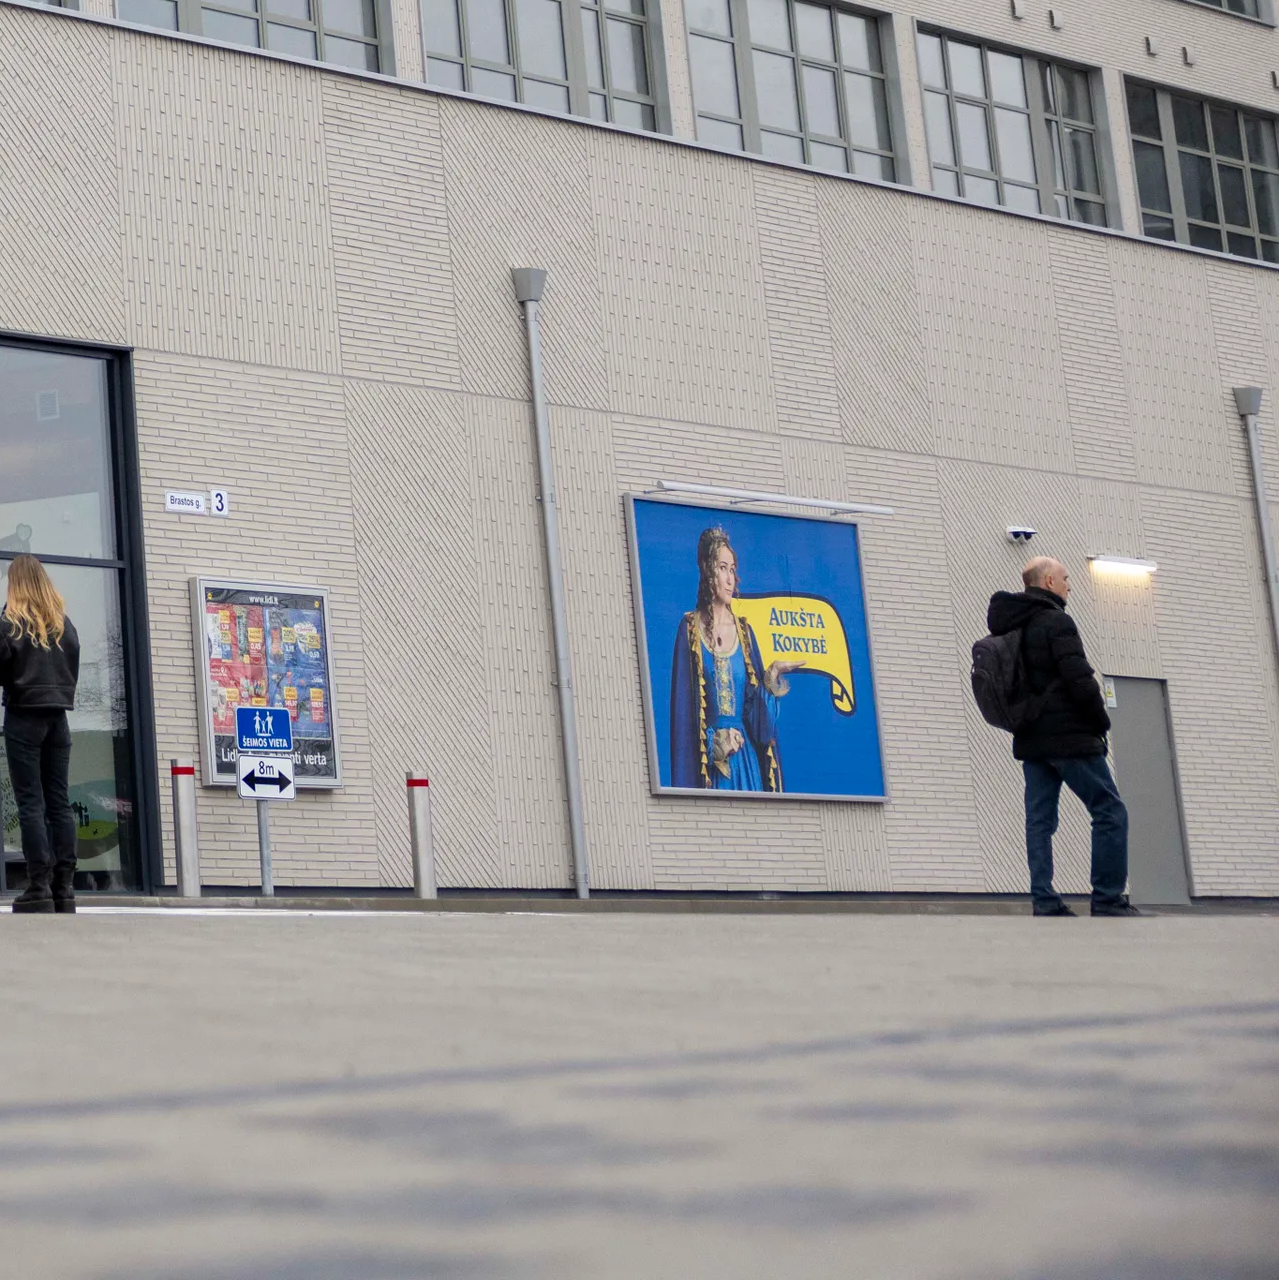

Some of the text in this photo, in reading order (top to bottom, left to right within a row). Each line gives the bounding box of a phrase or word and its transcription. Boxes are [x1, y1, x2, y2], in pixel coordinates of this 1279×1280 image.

[170, 495, 194, 507] Brastos
[215, 492, 225, 512] 3
[769, 607, 825, 628] AUKŠTA
[771, 633, 827, 654] KOKYBĖ
[242, 735, 288, 748] ŠEIMOS VIETA
[303, 752, 327, 766] verta
[258, 761, 275, 776] 8m
